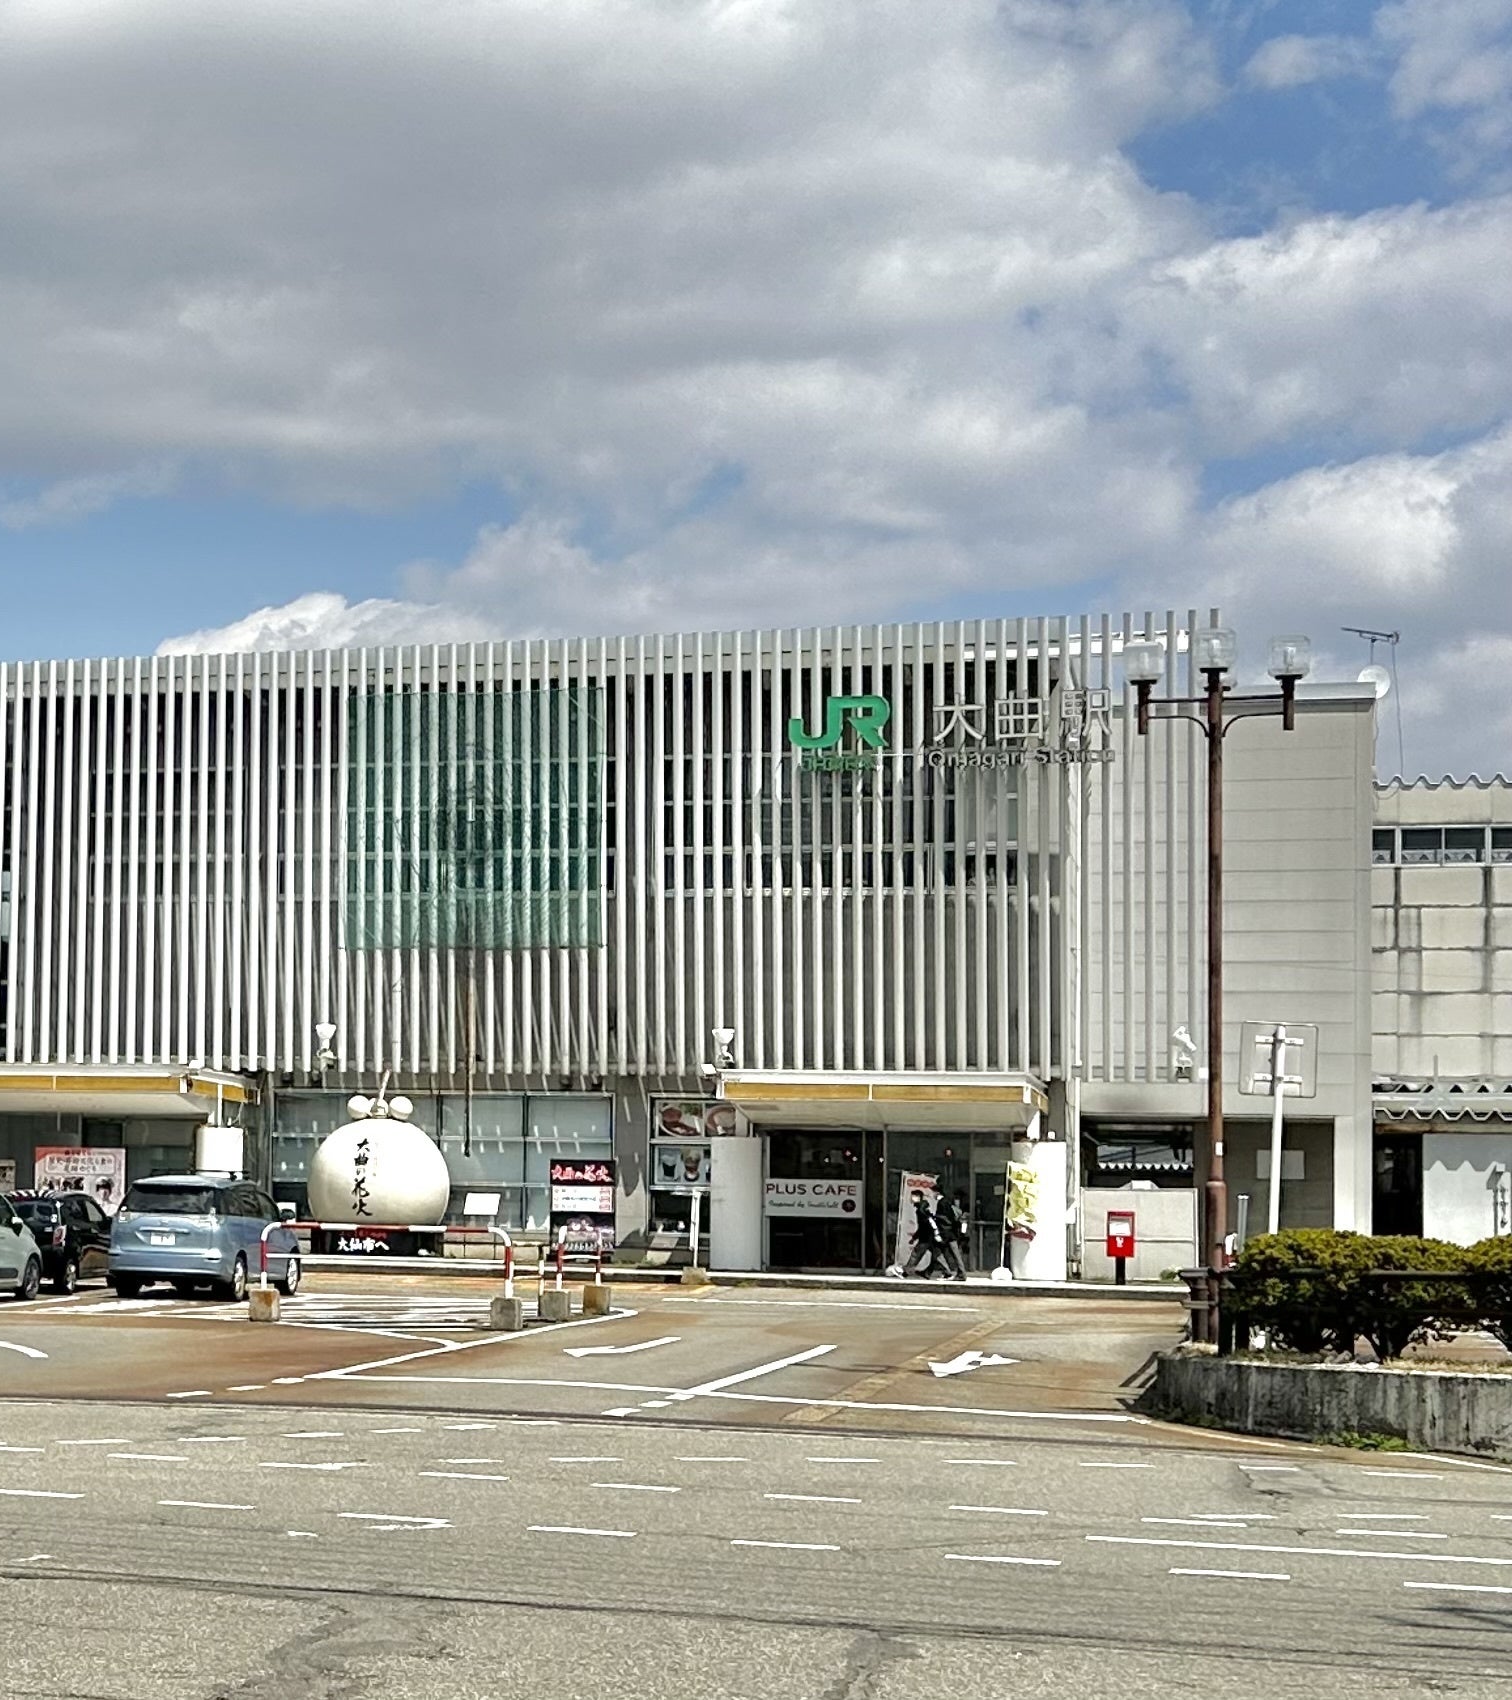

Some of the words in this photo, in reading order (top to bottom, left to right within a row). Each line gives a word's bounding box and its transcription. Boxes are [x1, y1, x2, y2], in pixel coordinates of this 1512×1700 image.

[789, 695, 890, 748] JR
[932, 687, 1112, 742] 大曲駅
[1034, 747, 1116, 764] Station
[351, 1138, 373, 1217] 大曲の花火
[765, 1183, 807, 1195] PLUS
[812, 1184, 857, 1196] CAFE
[337, 1237, 390, 1253] 大仙市へ
